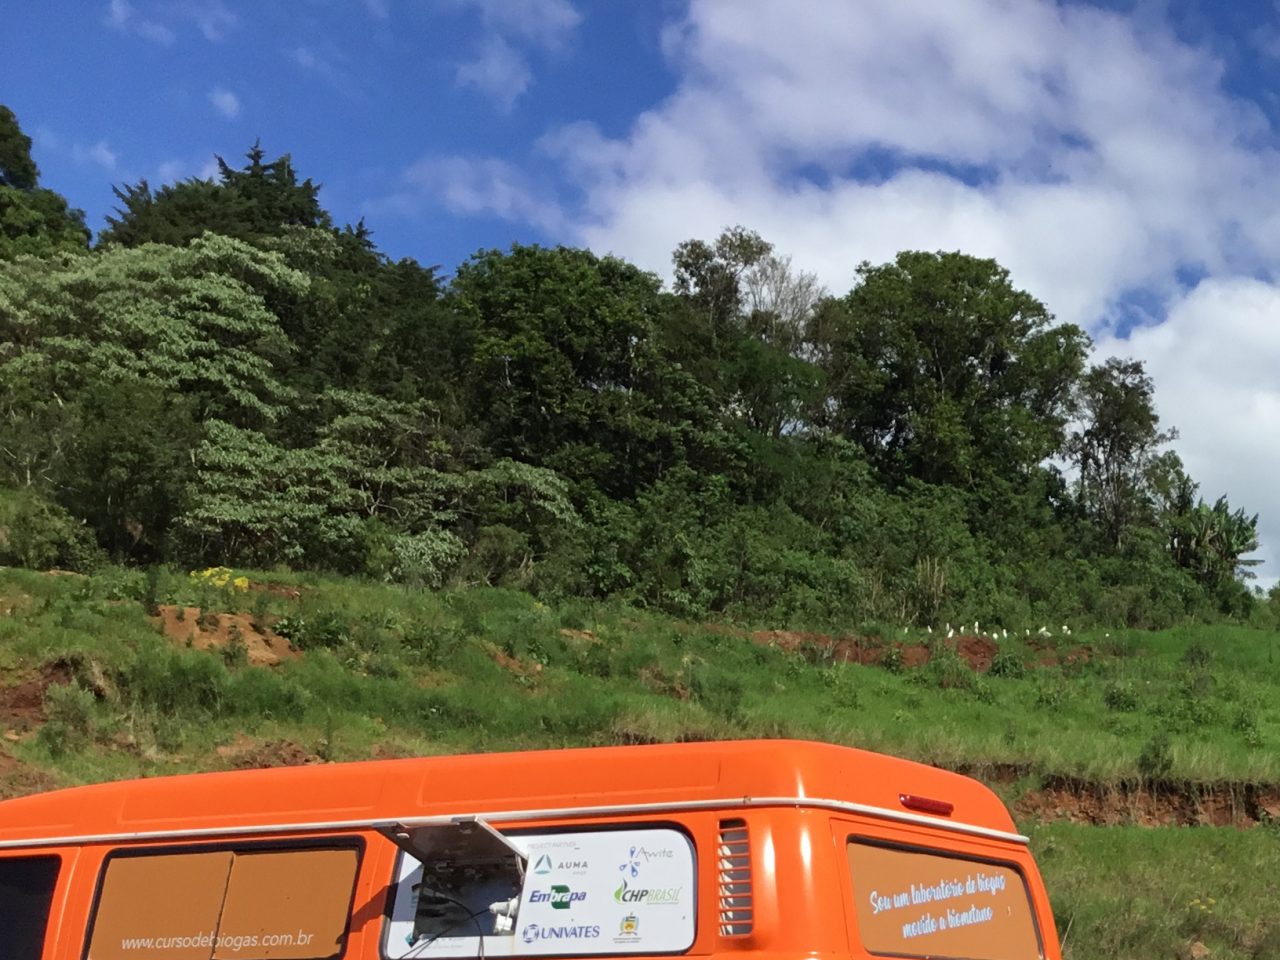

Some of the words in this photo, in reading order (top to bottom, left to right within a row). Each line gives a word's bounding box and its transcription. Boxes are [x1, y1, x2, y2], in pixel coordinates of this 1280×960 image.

[558, 861, 589, 869] AUMA
[529, 889, 587, 903] Embrapa
[870, 890, 891, 914] Sou
[893, 891, 911, 909] um
[966, 874, 976, 895] de
[902, 912, 937, 939] movido
[939, 916, 948, 930] a
[946, 903, 993, 929] biometano
[121, 929, 314, 951] www.cursodebiogas.com.br
[541, 925, 601, 939] UNIVATES
